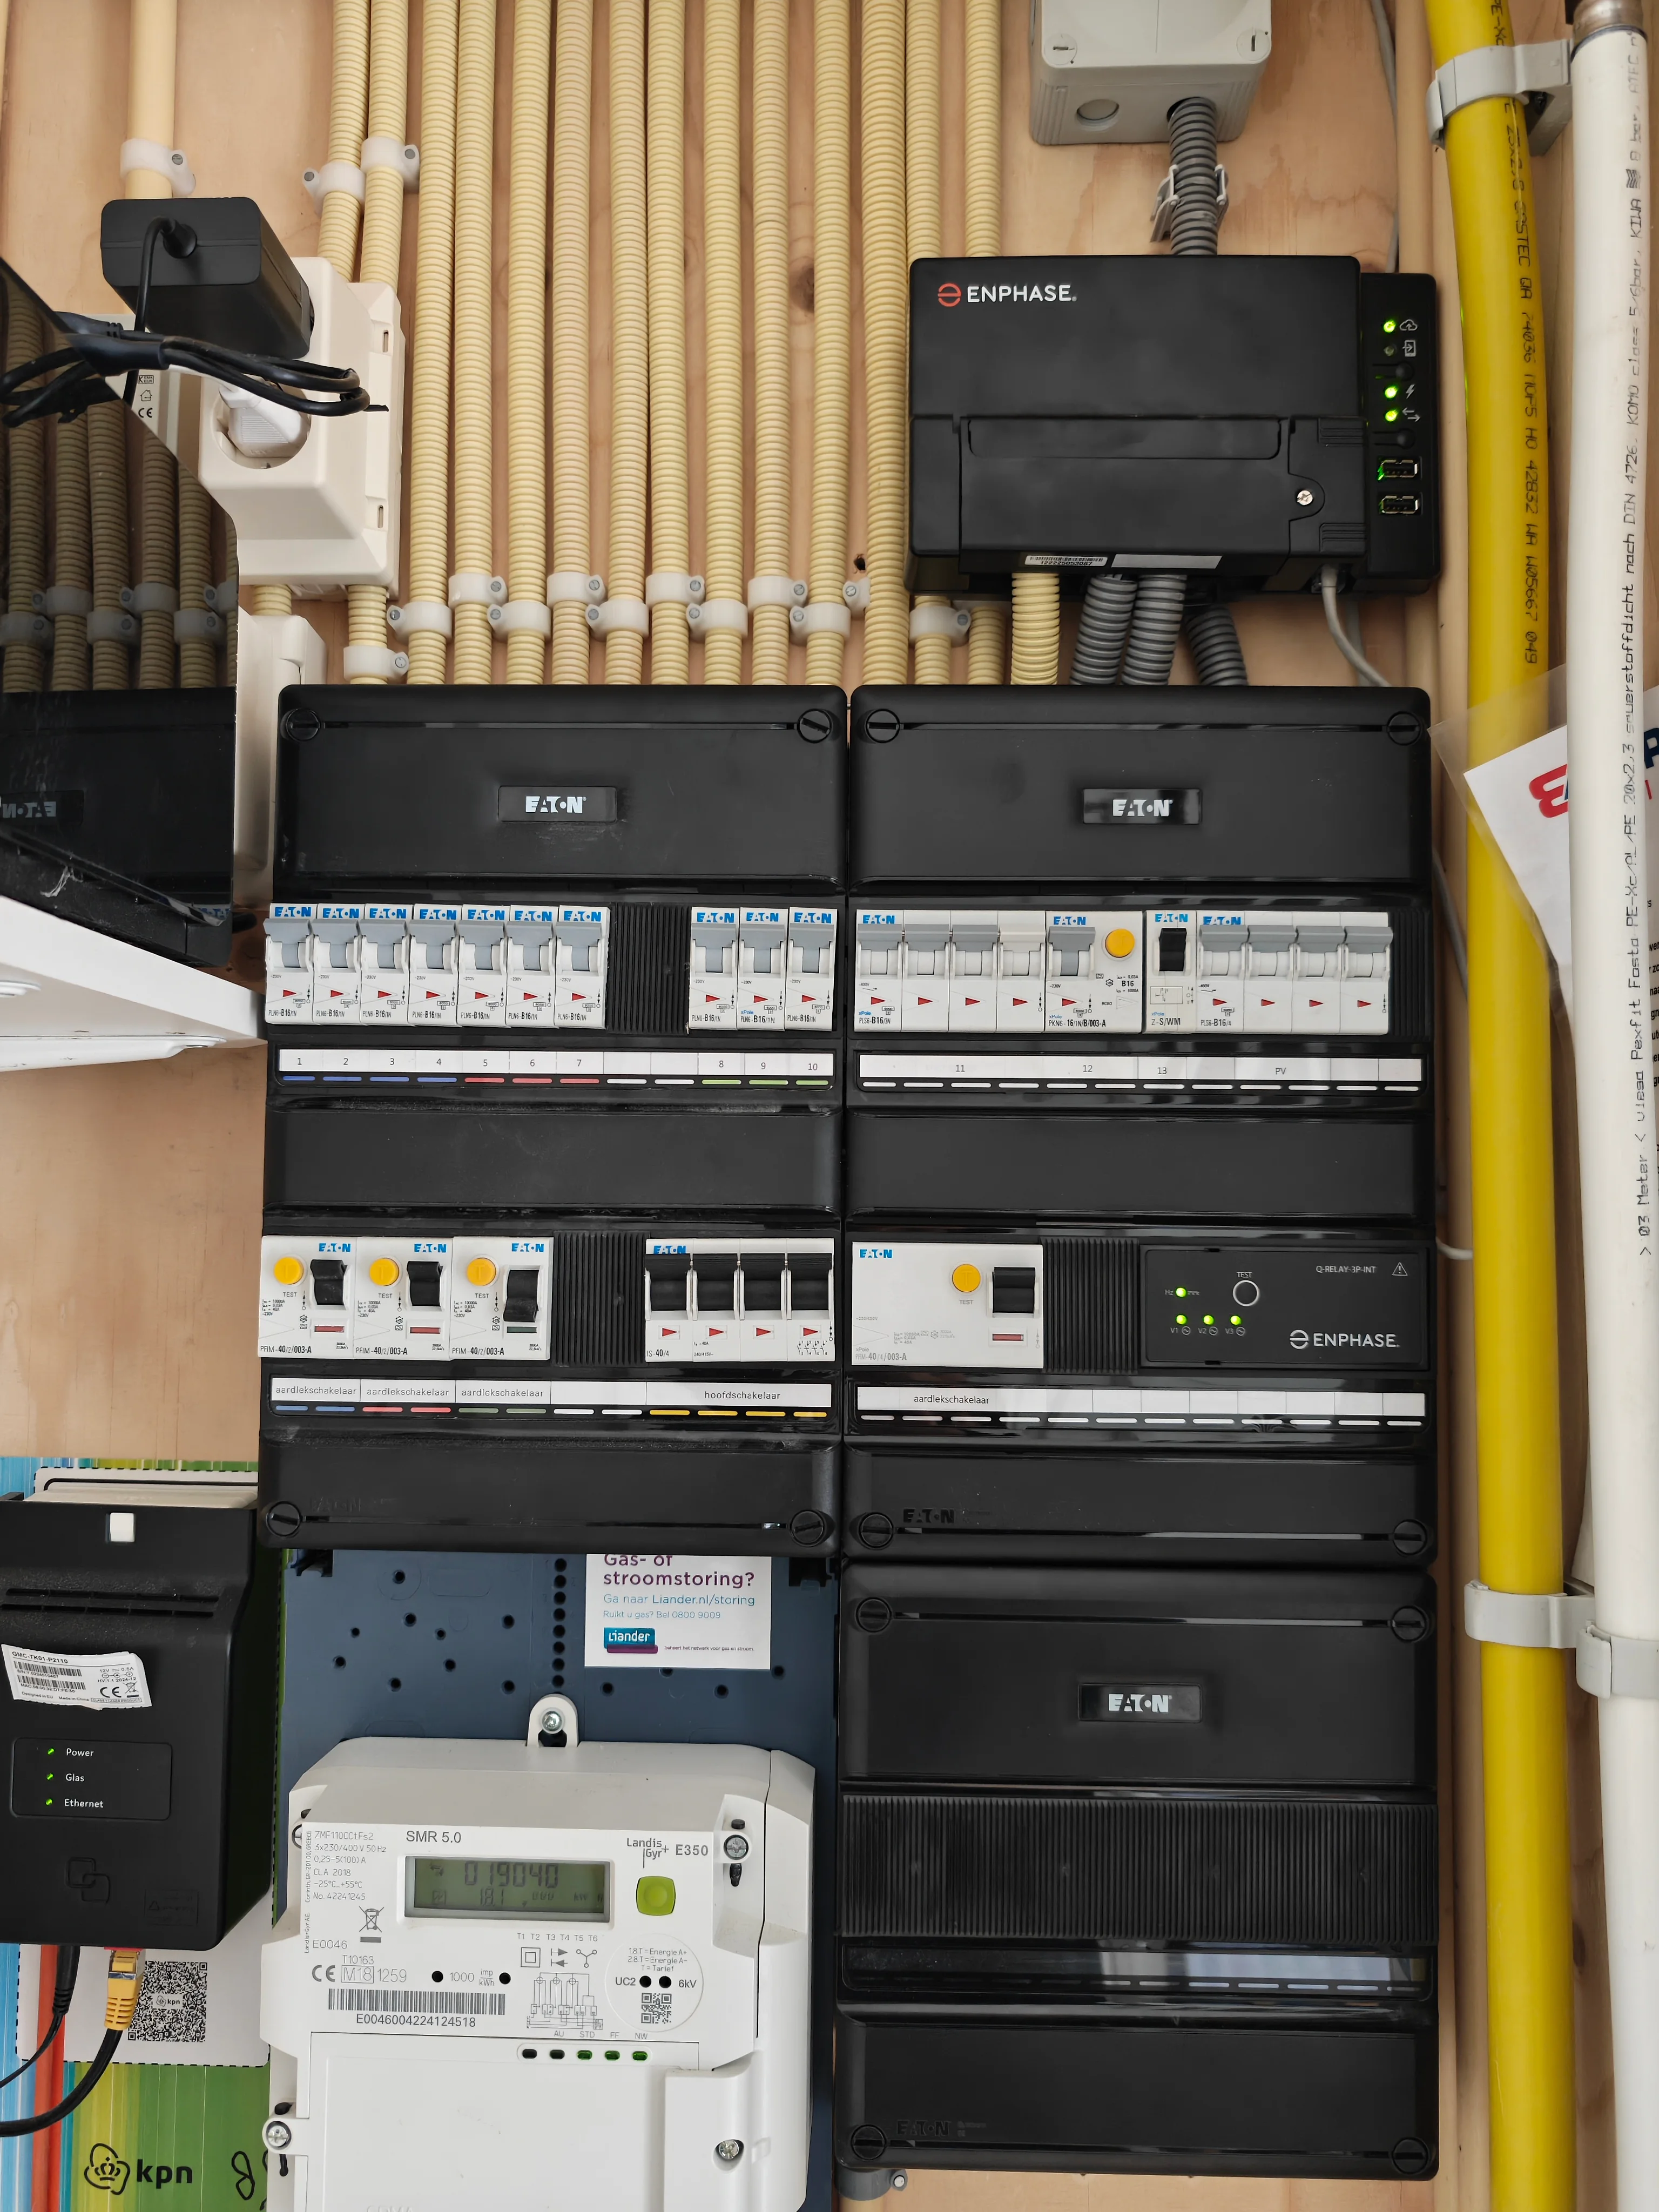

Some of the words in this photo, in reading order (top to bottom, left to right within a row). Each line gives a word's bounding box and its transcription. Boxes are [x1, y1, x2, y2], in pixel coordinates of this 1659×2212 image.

[1629, 199, 1642, 238] KIWA
[967, 285, 1072, 302] ENPHASE
[1627, 385, 1640, 425] KOMO
[1525, 461, 1539, 514] 42832
[1623, 494, 1636, 524] DIN
[1623, 534, 1635, 573] nach
[525, 796, 583, 813] EATON
[1112, 799, 1169, 817] EATON
[697, 913, 734, 923] EATON
[746, 913, 779, 921] EATON
[794, 913, 832, 923] EATON
[1054, 916, 1086, 925] EATON
[1628, 938, 1640, 988] Fosta
[577, 1059, 582, 1067] 7
[808, 1063, 818, 1071] 10
[1637, 1155, 1649, 1205] Meter
[319, 1243, 351, 1252] EATON
[414, 1244, 446, 1253] EATON
[511, 1243, 544, 1252] EATON
[860, 1249, 893, 1258] EATON
[1316, 1266, 1376, 1274] Q-RELAY-3P-INT
[1314, 1333, 1396, 1347] ENPHASE
[276, 1386, 356, 1395] aardlekschakelaar
[367, 1387, 449, 1397] aardlekschakelaar
[461, 1388, 543, 1397] aardlekschakelaar
[705, 1391, 780, 1400] hoofdschakelaar
[914, 1395, 989, 1404] aardlekschakelaar
[605, 1554, 646, 1566] Gas-
[604, 1572, 754, 1588] stroomstoring?
[604, 1594, 619, 1603] Ga
[624, 1595, 648, 1603] naar
[653, 1594, 754, 1606] Liander.nl/storing
[609, 1630, 650, 1642] Liander
[12, 1651, 68, 1663] GMC-TK01-P2110
[1109, 1694, 1169, 1712] EATON
[66, 1748, 94, 1757] Power
[65, 1773, 84, 1782] Glas
[64, 1799, 104, 1809] Ethernet
[406, 1830, 437, 1843] SMR
[442, 1831, 461, 1843] 5.0
[627, 1838, 662, 1848] Landis
[315, 1844, 358, 1853] 3x230/400
[676, 1845, 709, 1856] E350
[327, 1892, 366, 1900] 42241245
[313, 1940, 347, 1948] E0046
[650, 1948, 678, 1957] Energie
[650, 1957, 678, 1965] Energie
[343, 1967, 372, 1981] M18
[377, 1968, 407, 1982] 1259
[449, 1972, 474, 1982] 1000
[481, 1969, 493, 1977] imp
[616, 1977, 636, 1986] UC2
[679, 1979, 697, 1988] 6kV
[167, 1998, 180, 2006] kpn
[356, 2014, 476, 2027] E0046004224124518
[137, 2159, 192, 2189] kpn
